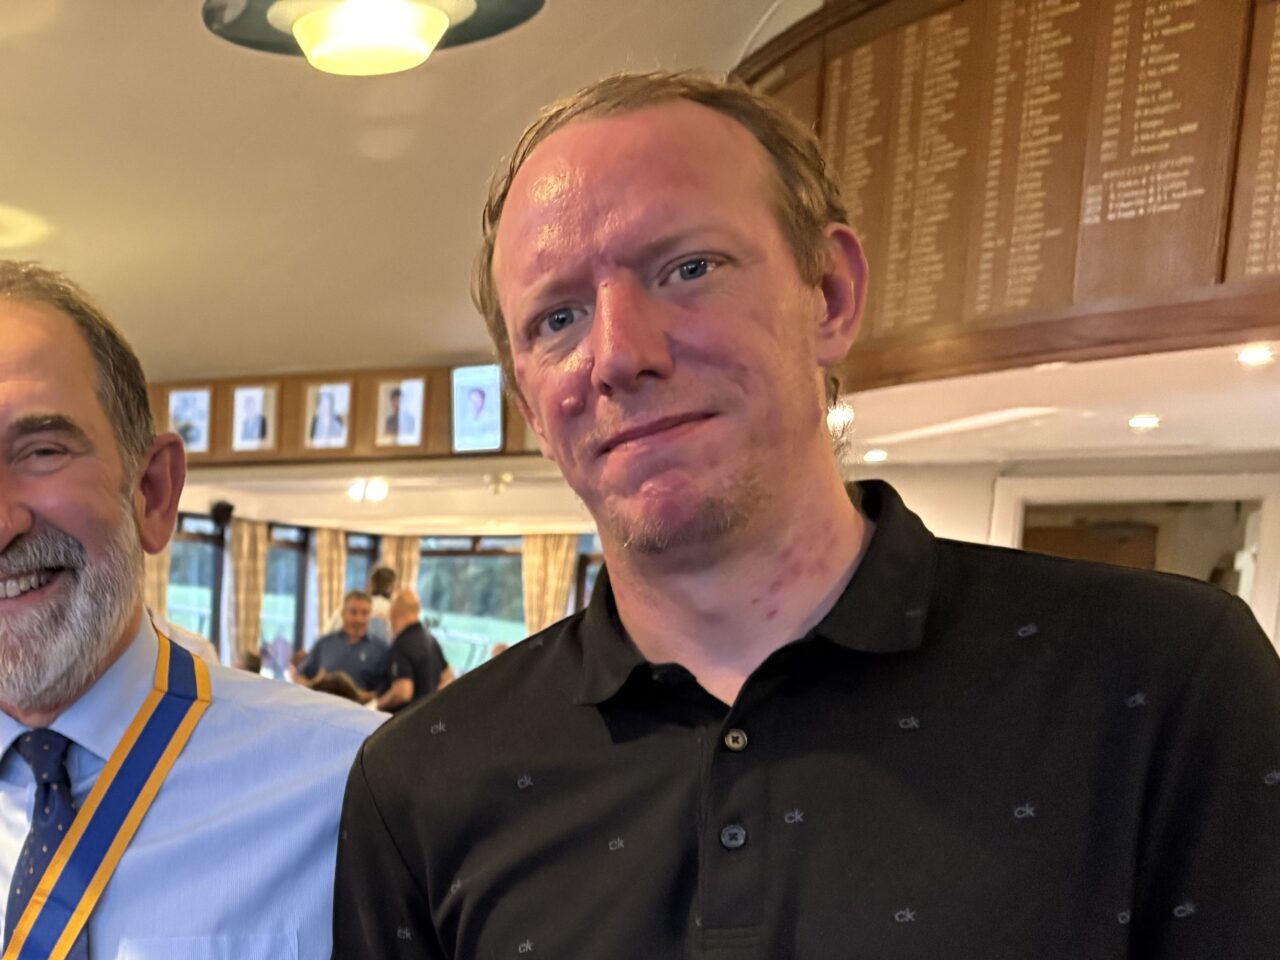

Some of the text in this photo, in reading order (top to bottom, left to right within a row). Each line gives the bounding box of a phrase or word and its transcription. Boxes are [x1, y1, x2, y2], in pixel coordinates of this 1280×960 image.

[430, 720, 447, 734] ck
[898, 714, 920, 729] ck
[517, 774, 535, 789] ck
[784, 808, 804, 824] ck
[1013, 802, 1036, 819] ck
[608, 835, 626, 851] ck
[894, 906, 916, 922] ck
[396, 926, 413, 940] ck
[518, 938, 534, 954] ck
